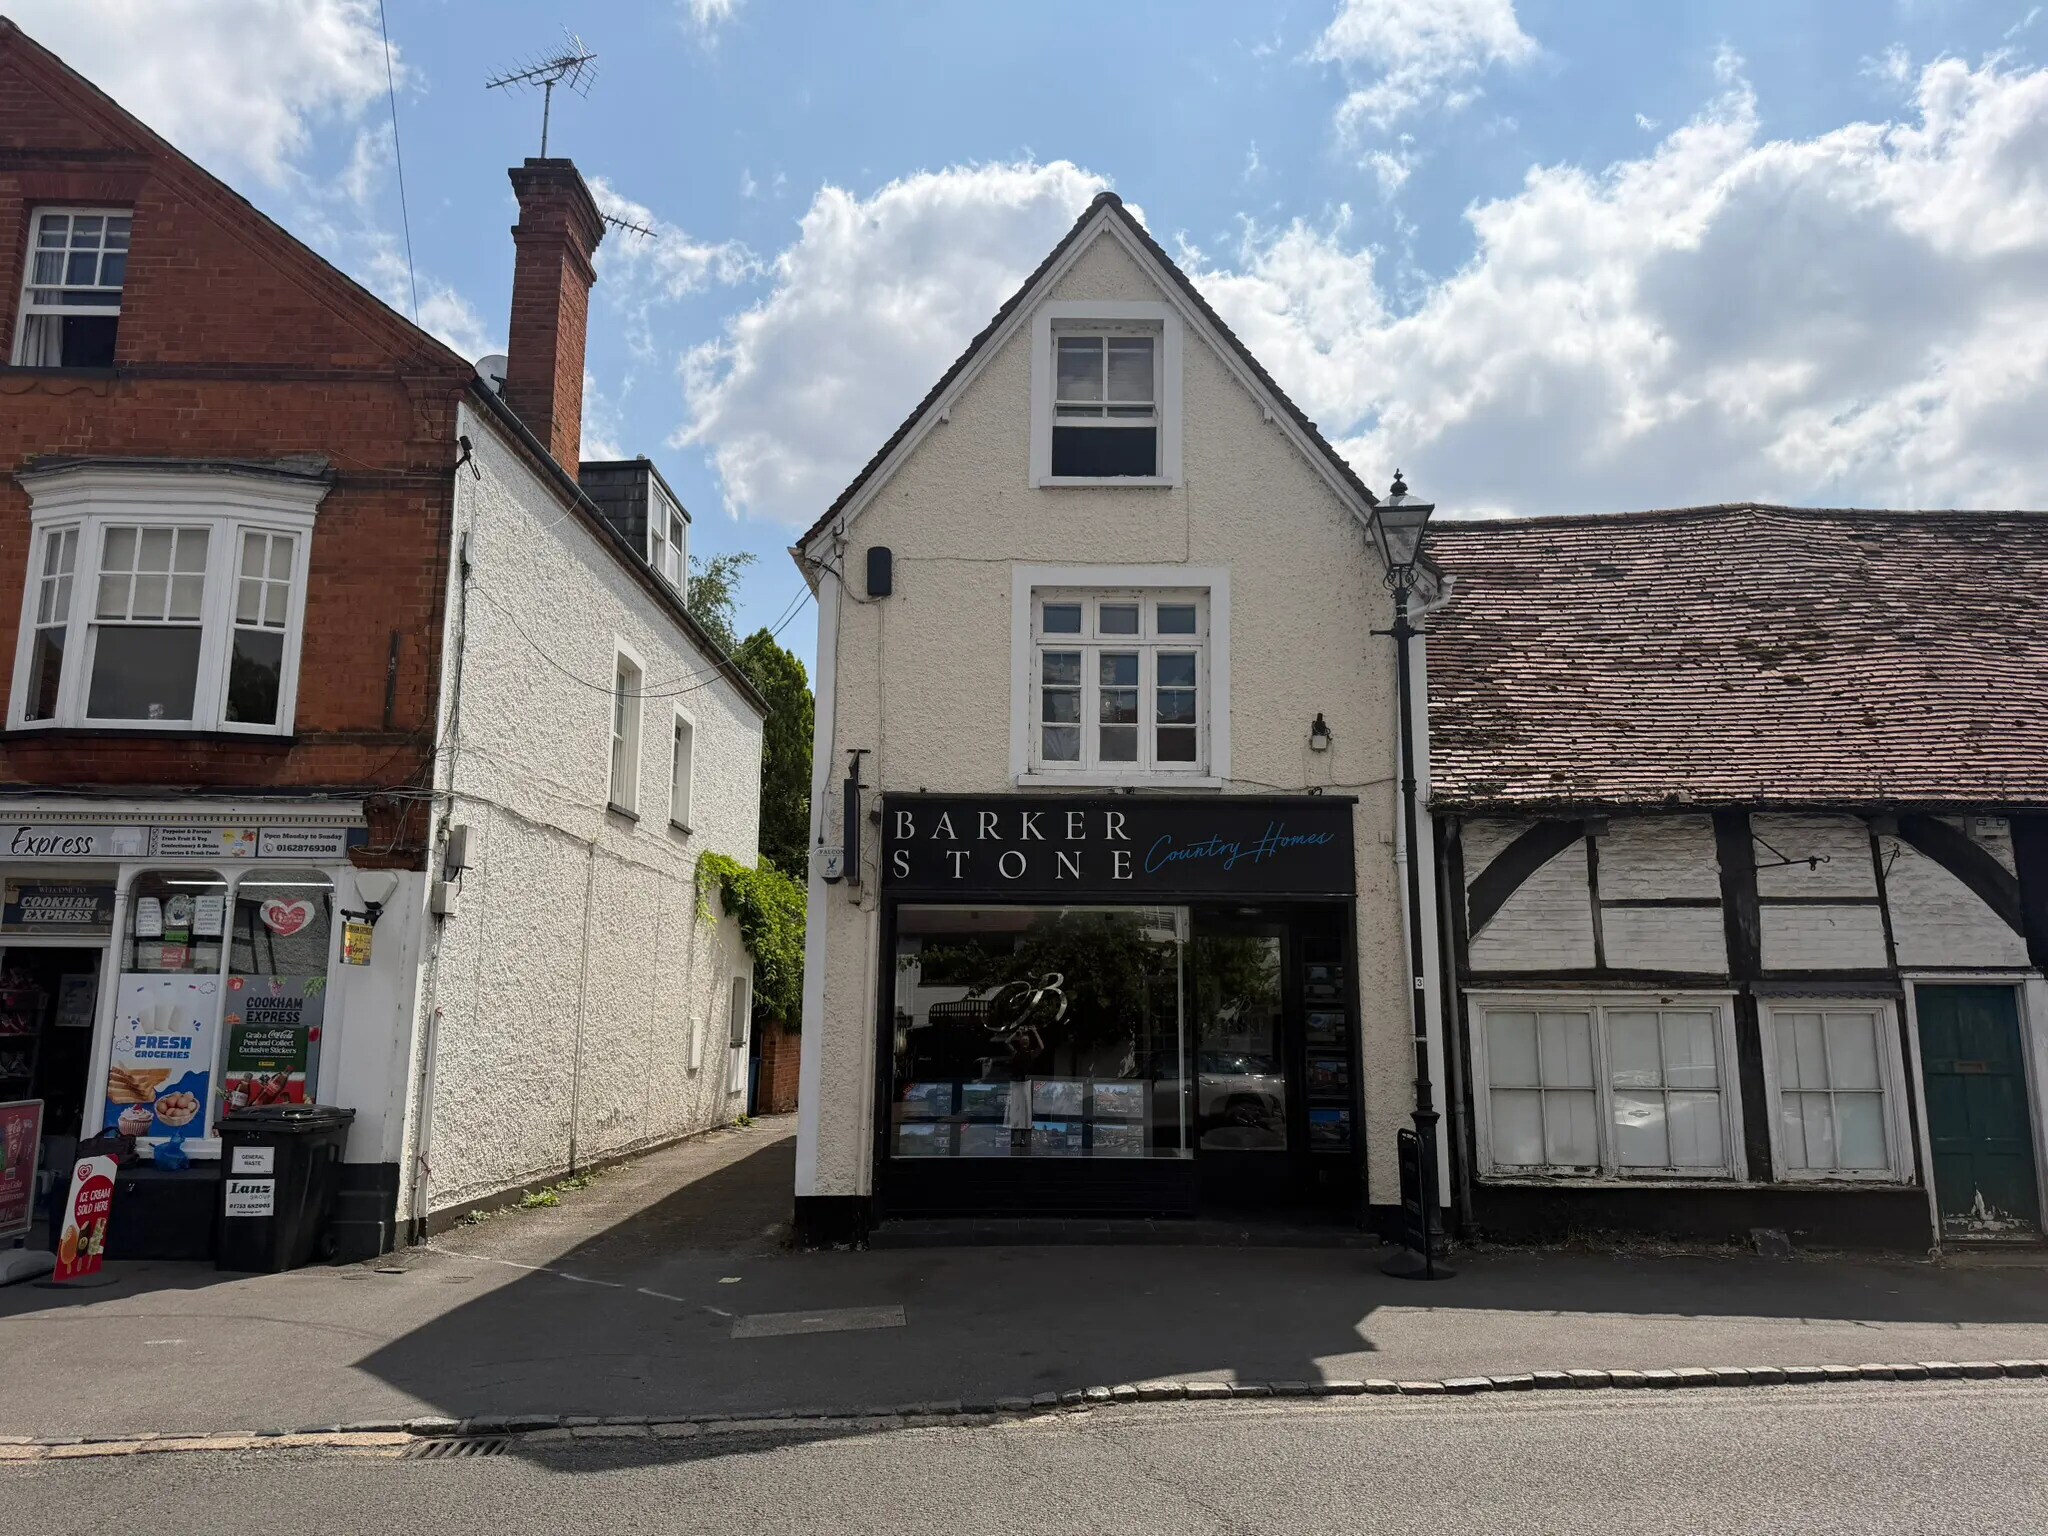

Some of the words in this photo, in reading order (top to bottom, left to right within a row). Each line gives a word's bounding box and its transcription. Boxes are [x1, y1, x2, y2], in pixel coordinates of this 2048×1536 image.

[893, 811, 1131, 840] BARKER
[11, 827, 93, 856] Express
[1144, 833, 1242, 872] Country
[1252, 821, 1334, 863] Homes
[893, 850, 1133, 880] STONE
[21, 896, 99, 908] COOKHAM
[23, 910, 93, 920] EXPRESS
[246, 997, 304, 1008] COOKHAM
[246, 1011, 300, 1022] EXPRESS
[135, 1036, 192, 1049] FRESH
[271, 1039, 294, 1047] Collect
[135, 1051, 190, 1059] GROCERIES
[230, 1182, 271, 1194] Lanz
[79, 1191, 89, 1202] ICE
[90, 1188, 111, 1201] CREAM
[77, 1203, 93, 1216] SOLD
[94, 1200, 108, 1212] HERE
